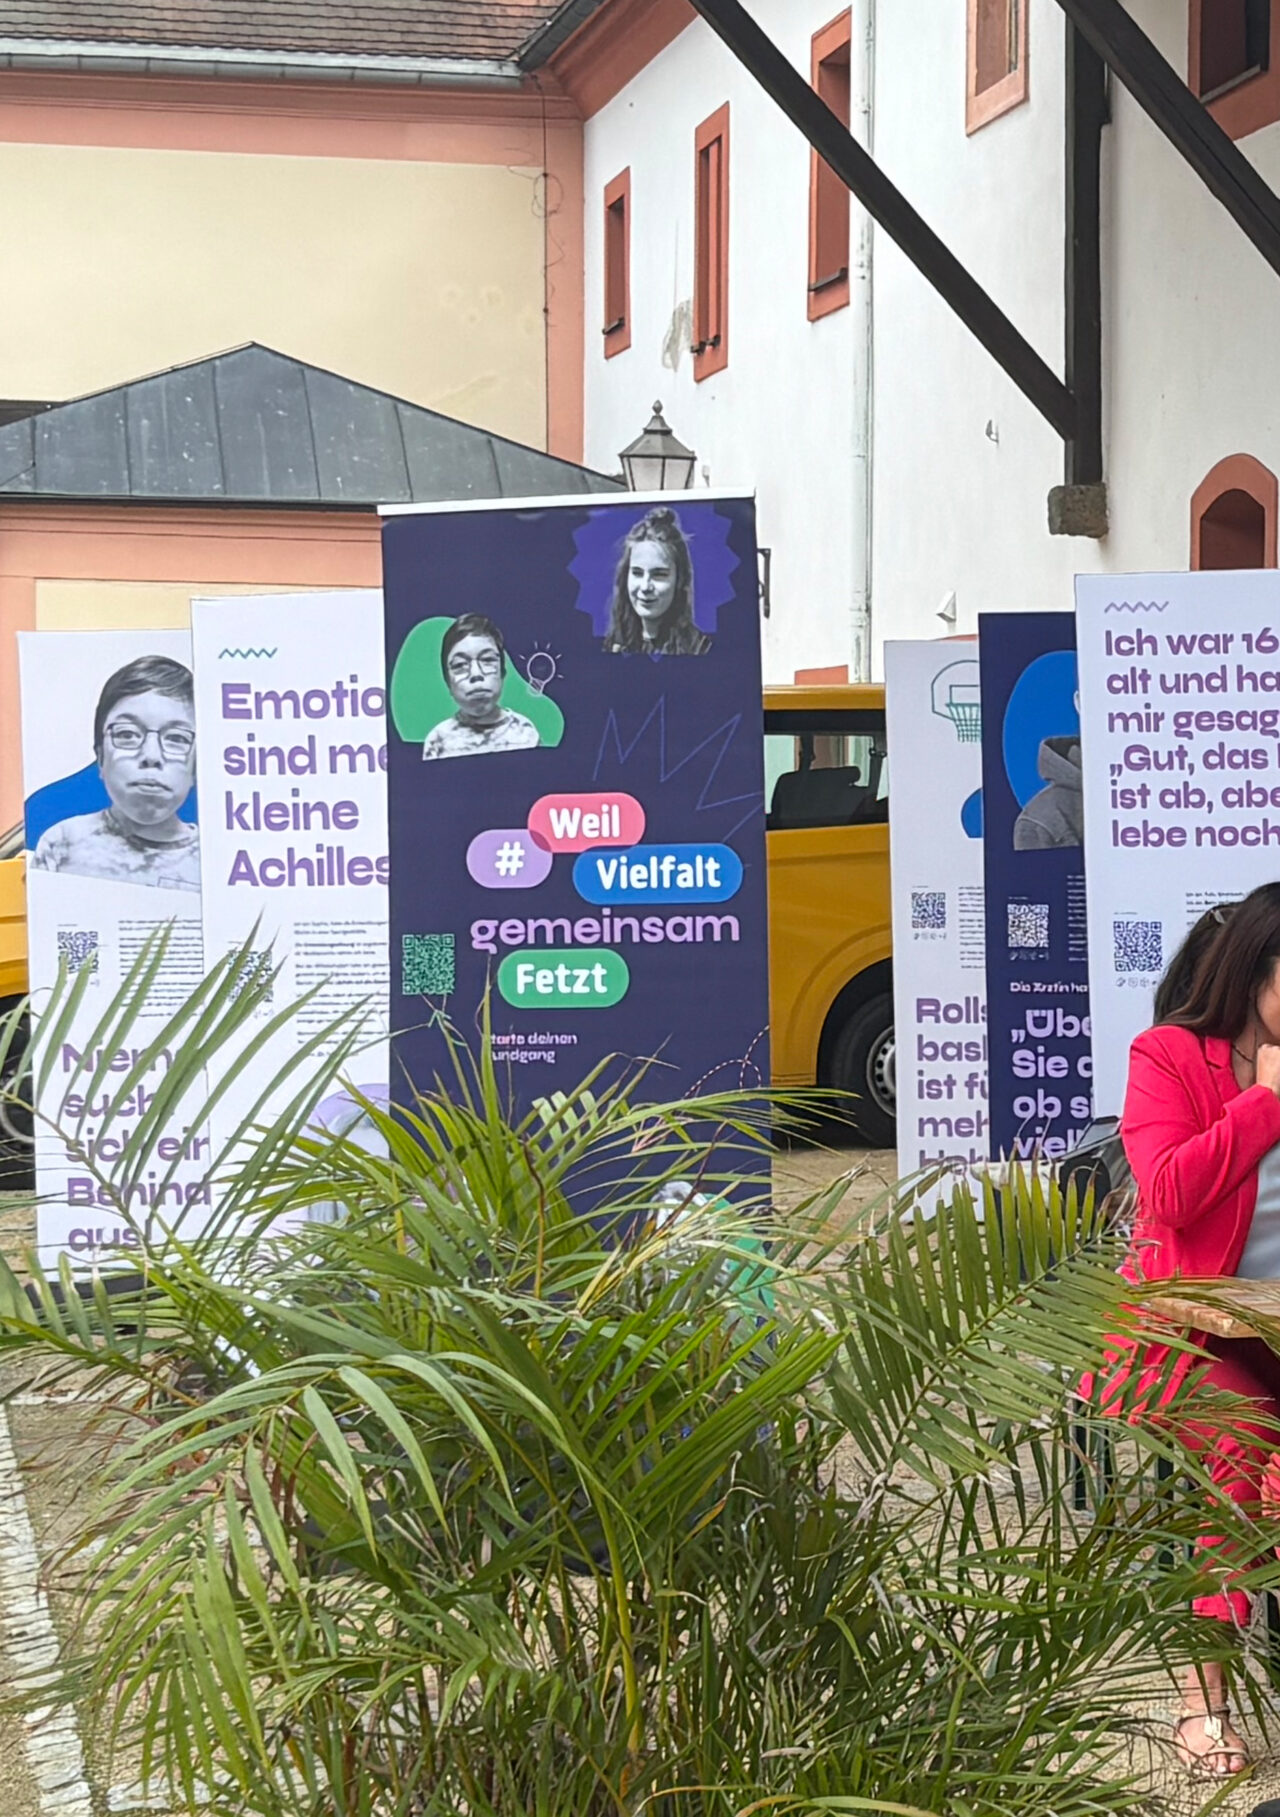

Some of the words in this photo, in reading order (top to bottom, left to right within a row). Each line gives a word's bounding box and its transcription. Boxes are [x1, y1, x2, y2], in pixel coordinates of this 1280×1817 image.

[1105, 628, 1158, 656] Ich
[1166, 631, 1233, 655] war
[1242, 627, 1280, 654] 16
[1106, 666, 1151, 695] alt
[1159, 664, 1228, 694] und
[1108, 702, 1165, 733] mir
[223, 732, 317, 776] sind
[1110, 742, 1195, 777] „Gut,
[1202, 742, 1269, 771] das
[225, 787, 359, 832] kleine
[1110, 778, 1151, 810] ist
[1158, 780, 1214, 814] ab,
[549, 804, 620, 839] Weil
[1111, 819, 1187, 848] lebe
[495, 841, 525, 876] #
[596, 854, 721, 890] Vielfalt
[470, 907, 740, 955] gemeinsam
[516, 962, 608, 995] Fetzt
[491, 1030, 525, 1045] tarte
[527, 1031, 578, 1045] deinen
[491, 1047, 556, 1064] undgang
[1012, 1045, 1069, 1078] Sie
[918, 1069, 957, 1100] ist
[1013, 1088, 1062, 1118] ob
